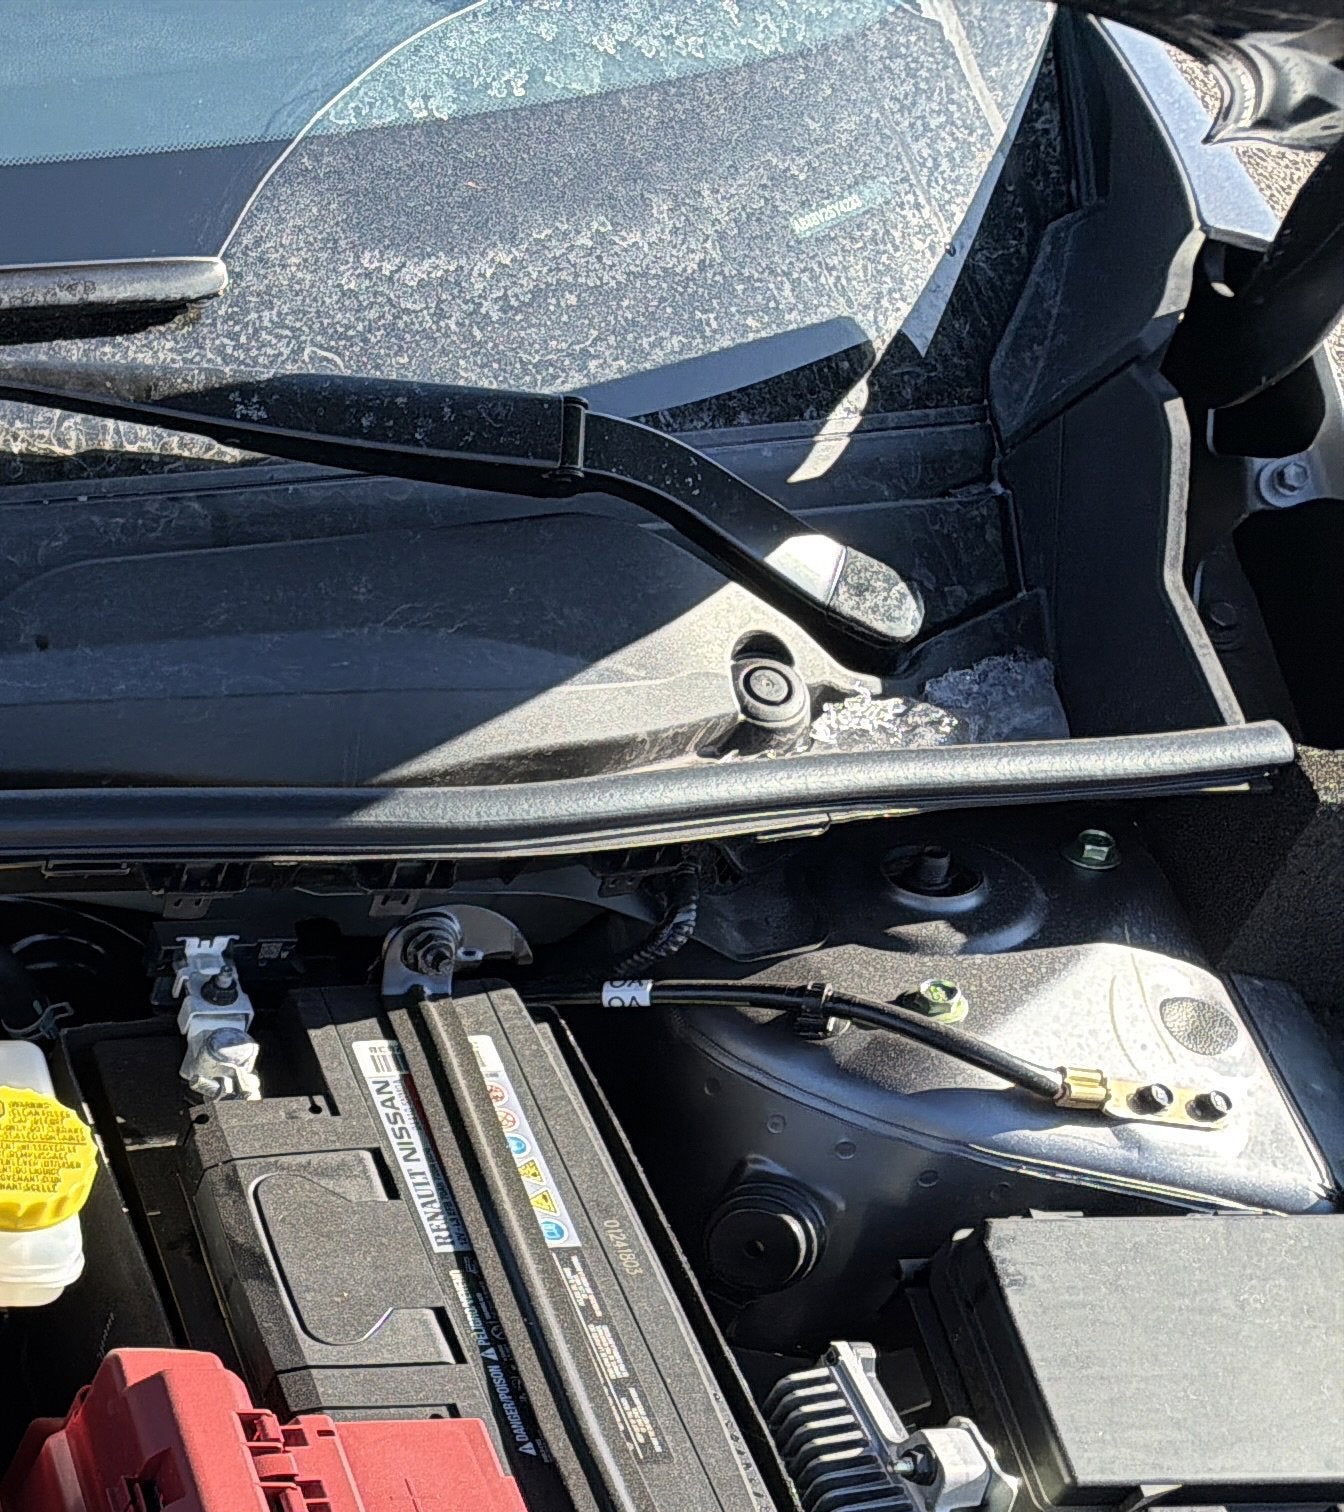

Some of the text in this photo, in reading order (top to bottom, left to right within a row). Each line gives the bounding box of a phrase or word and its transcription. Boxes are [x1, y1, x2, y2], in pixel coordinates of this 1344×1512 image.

[371, 1079, 455, 1247] RENAULT NISSAN
[487, 1364, 529, 1442] DANGER/POISON
